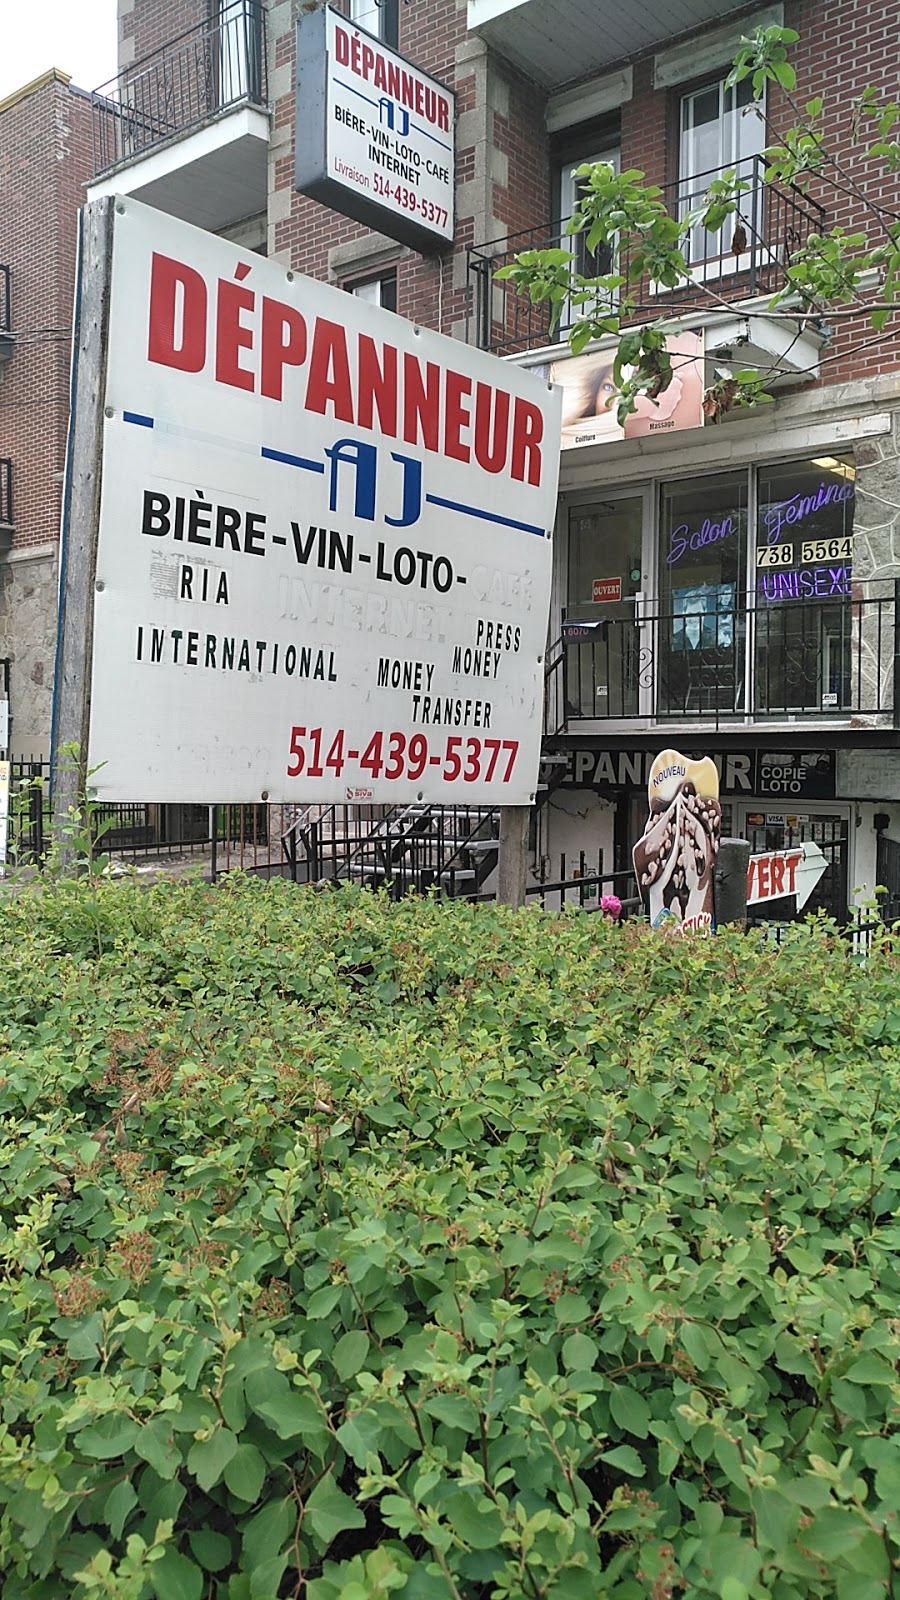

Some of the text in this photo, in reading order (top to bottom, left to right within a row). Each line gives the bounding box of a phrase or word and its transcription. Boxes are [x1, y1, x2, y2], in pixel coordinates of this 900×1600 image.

[335, 25, 450, 133] DÉPANNEUR
[368, 144, 421, 186] INTERNET
[334, 156, 448, 228] Livraison 514-439-5377
[148, 251, 544, 487] DÉPANNEUR
[649, 420, 675, 430] Massage
[666, 482, 854, 563] Salon Femina
[757, 538, 852, 566] 738 5564
[594, 584, 620, 596] OUVERT
[476, 619, 521, 653] PRESS
[136, 626, 435, 692] INTERNATIONAL MONEY
[452, 645, 501, 679] MONEY
[412, 694, 491, 728] TRANSFER
[287, 726, 520, 783] 514-439-5377
[653, 765, 686, 788] NOUVEAU
[761, 766, 807, 780] COPIE
[761, 780, 802, 792] LOTO
[768, 815, 784, 823] VISA
